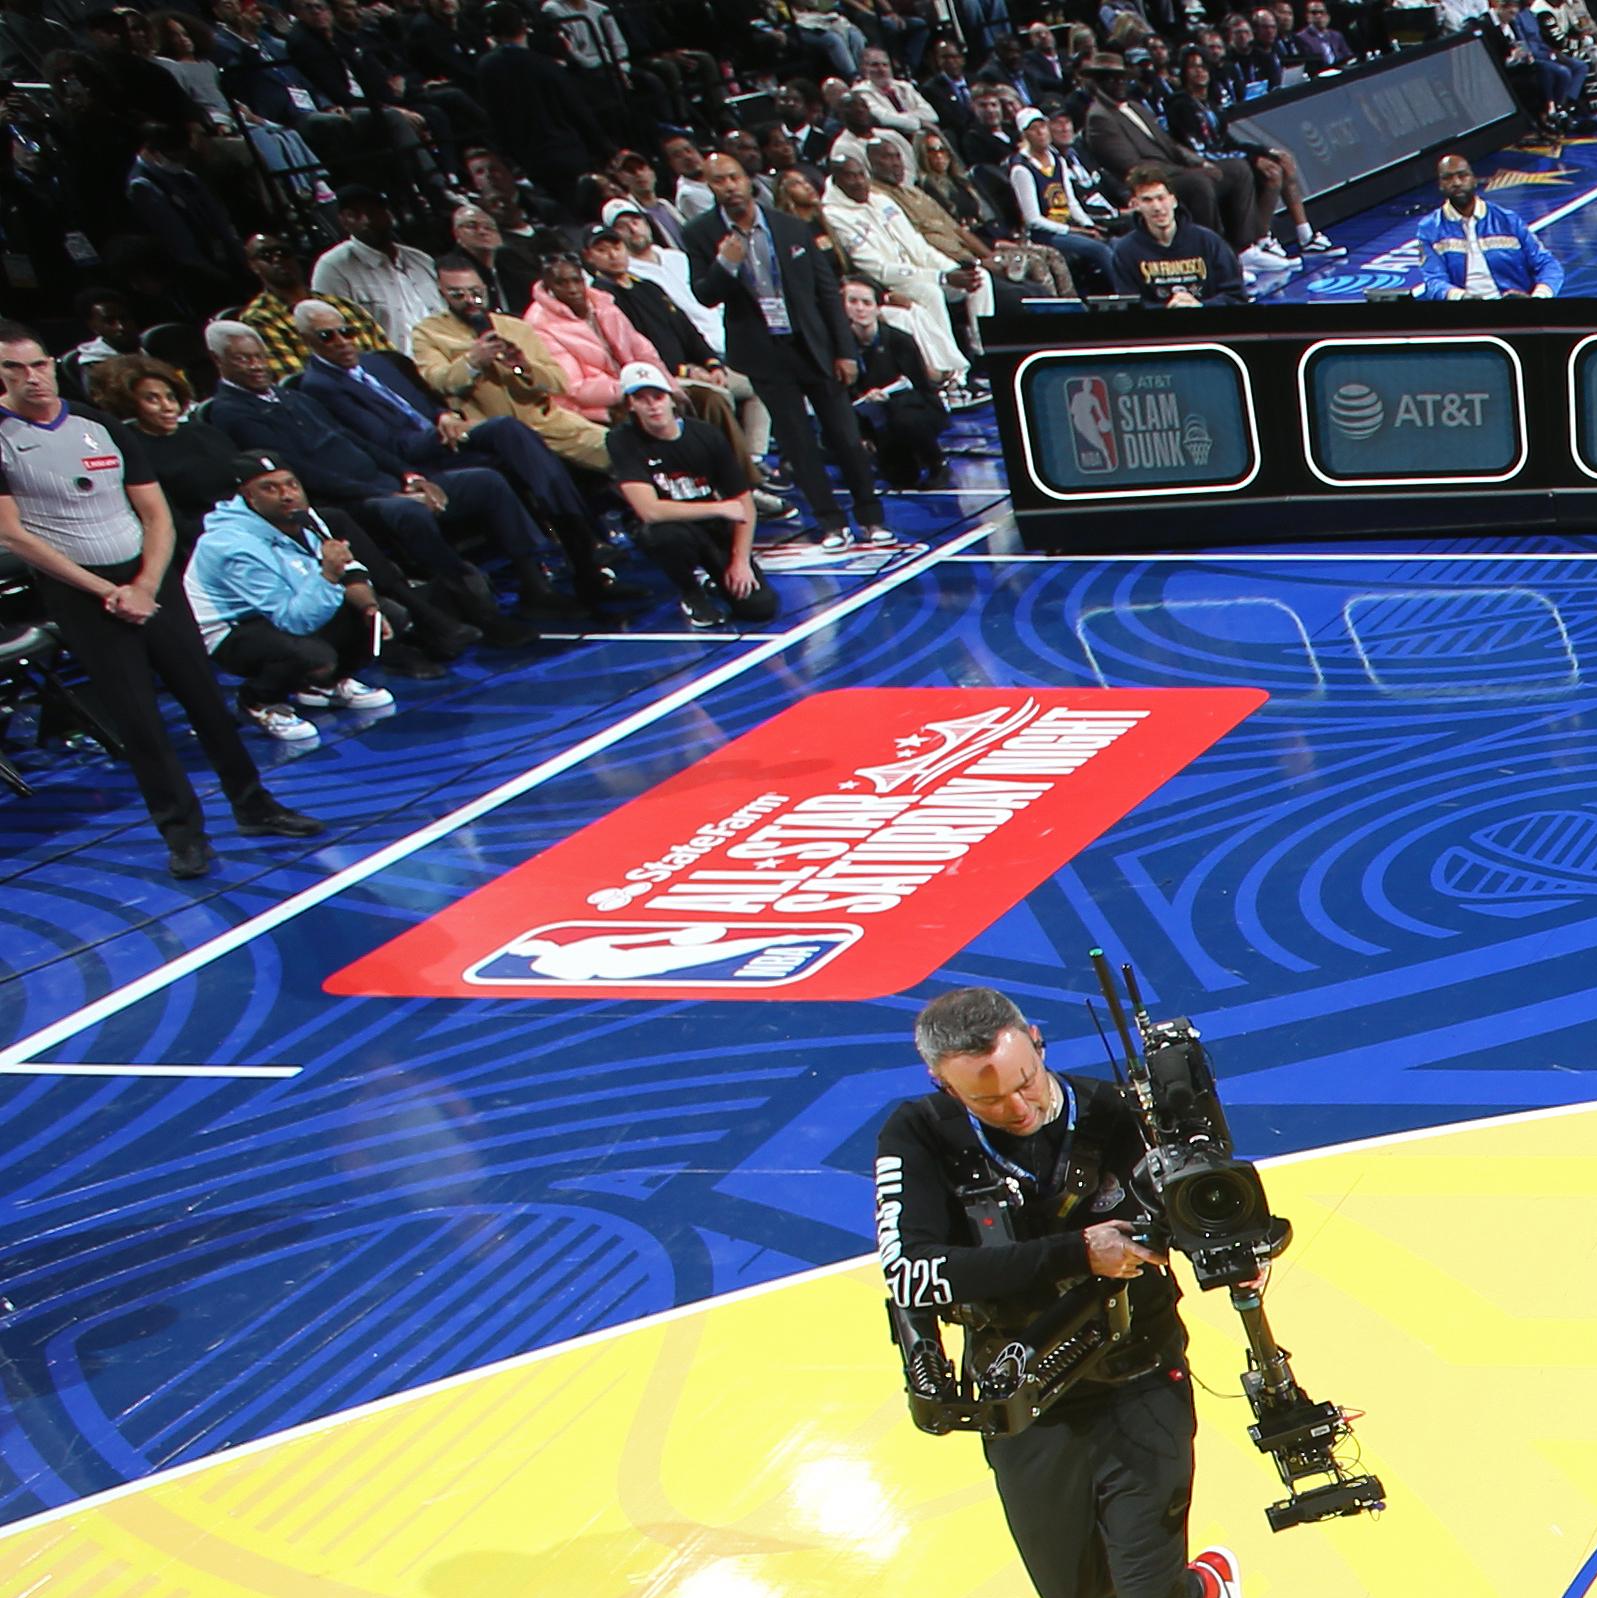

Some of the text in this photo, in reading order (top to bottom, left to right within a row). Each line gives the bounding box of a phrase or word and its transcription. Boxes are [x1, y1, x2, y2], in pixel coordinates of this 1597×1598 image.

[1136, 374, 1173, 388] AT&T
[1117, 392, 1181, 432] SLAM
[1394, 392, 1490, 428] AT&T
[1123, 430, 1186, 470] DUNK
[772, 706, 1151, 914] SATURDAY NIGHT
[734, 946, 821, 977] NBA
[886, 1256, 953, 1309] 025
